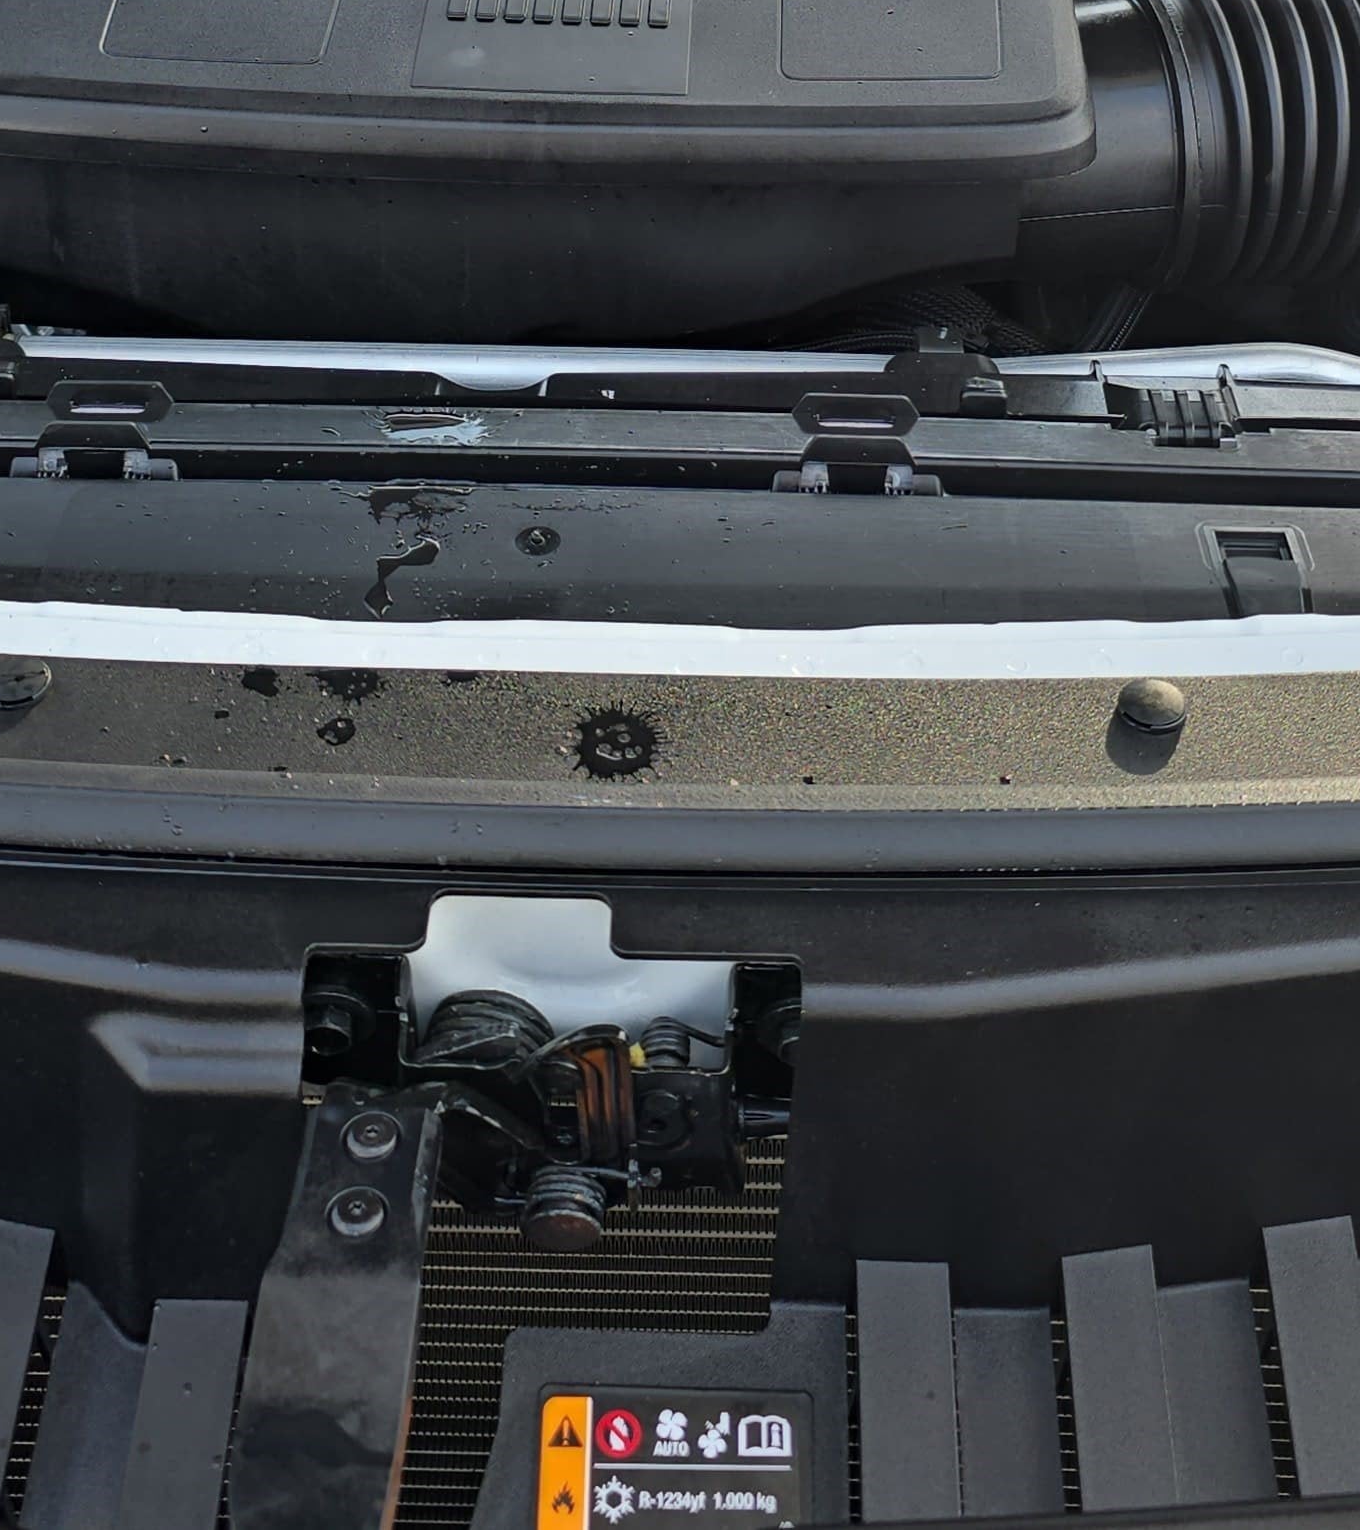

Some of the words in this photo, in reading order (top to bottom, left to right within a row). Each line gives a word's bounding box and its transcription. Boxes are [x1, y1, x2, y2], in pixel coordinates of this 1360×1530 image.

[652, 1440, 690, 1457] AUTO
[639, 1490, 707, 1514] R-1234yf
[713, 1490, 755, 1511] 1.000
[756, 1491, 778, 1515] kg
